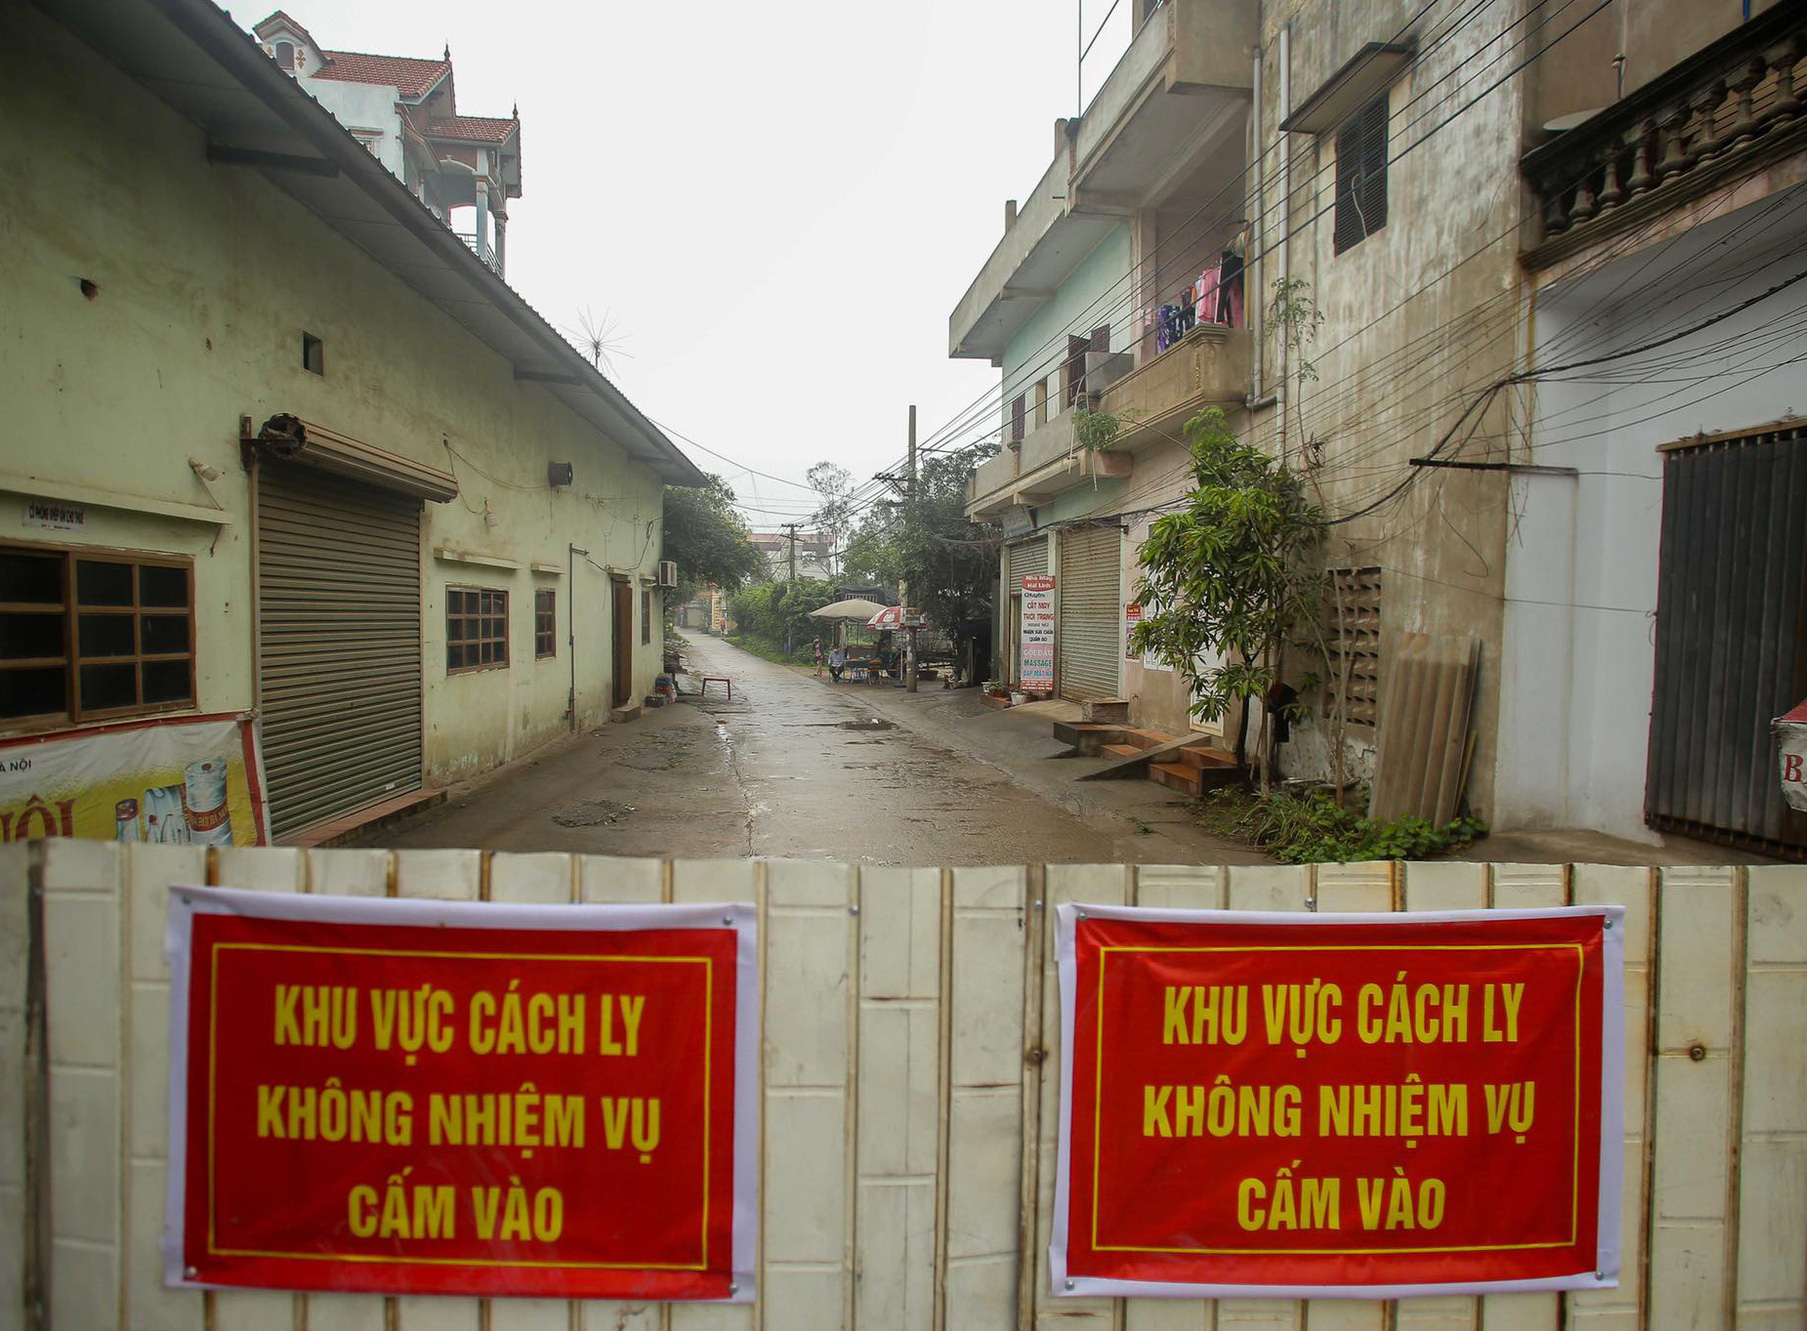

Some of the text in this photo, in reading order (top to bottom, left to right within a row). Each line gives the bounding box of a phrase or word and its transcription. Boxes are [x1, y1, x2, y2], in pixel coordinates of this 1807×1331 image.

[1024, 659, 1052, 667] MASSAGE
[10, 758, 32, 772] NỘI
[274, 979, 646, 1066] KHU VỰC CÁCH LY
[1162, 970, 1526, 1059] KHU VỰC CÁCH LY
[257, 1077, 661, 1164] KHÔNG NHIỆM VỤ
[1142, 1073, 1536, 1149] KHÔNG NHIỆM VỤ
[348, 1167, 564, 1243] CẤM VÀO
[1236, 1159, 1446, 1232] CẤM VÀO
